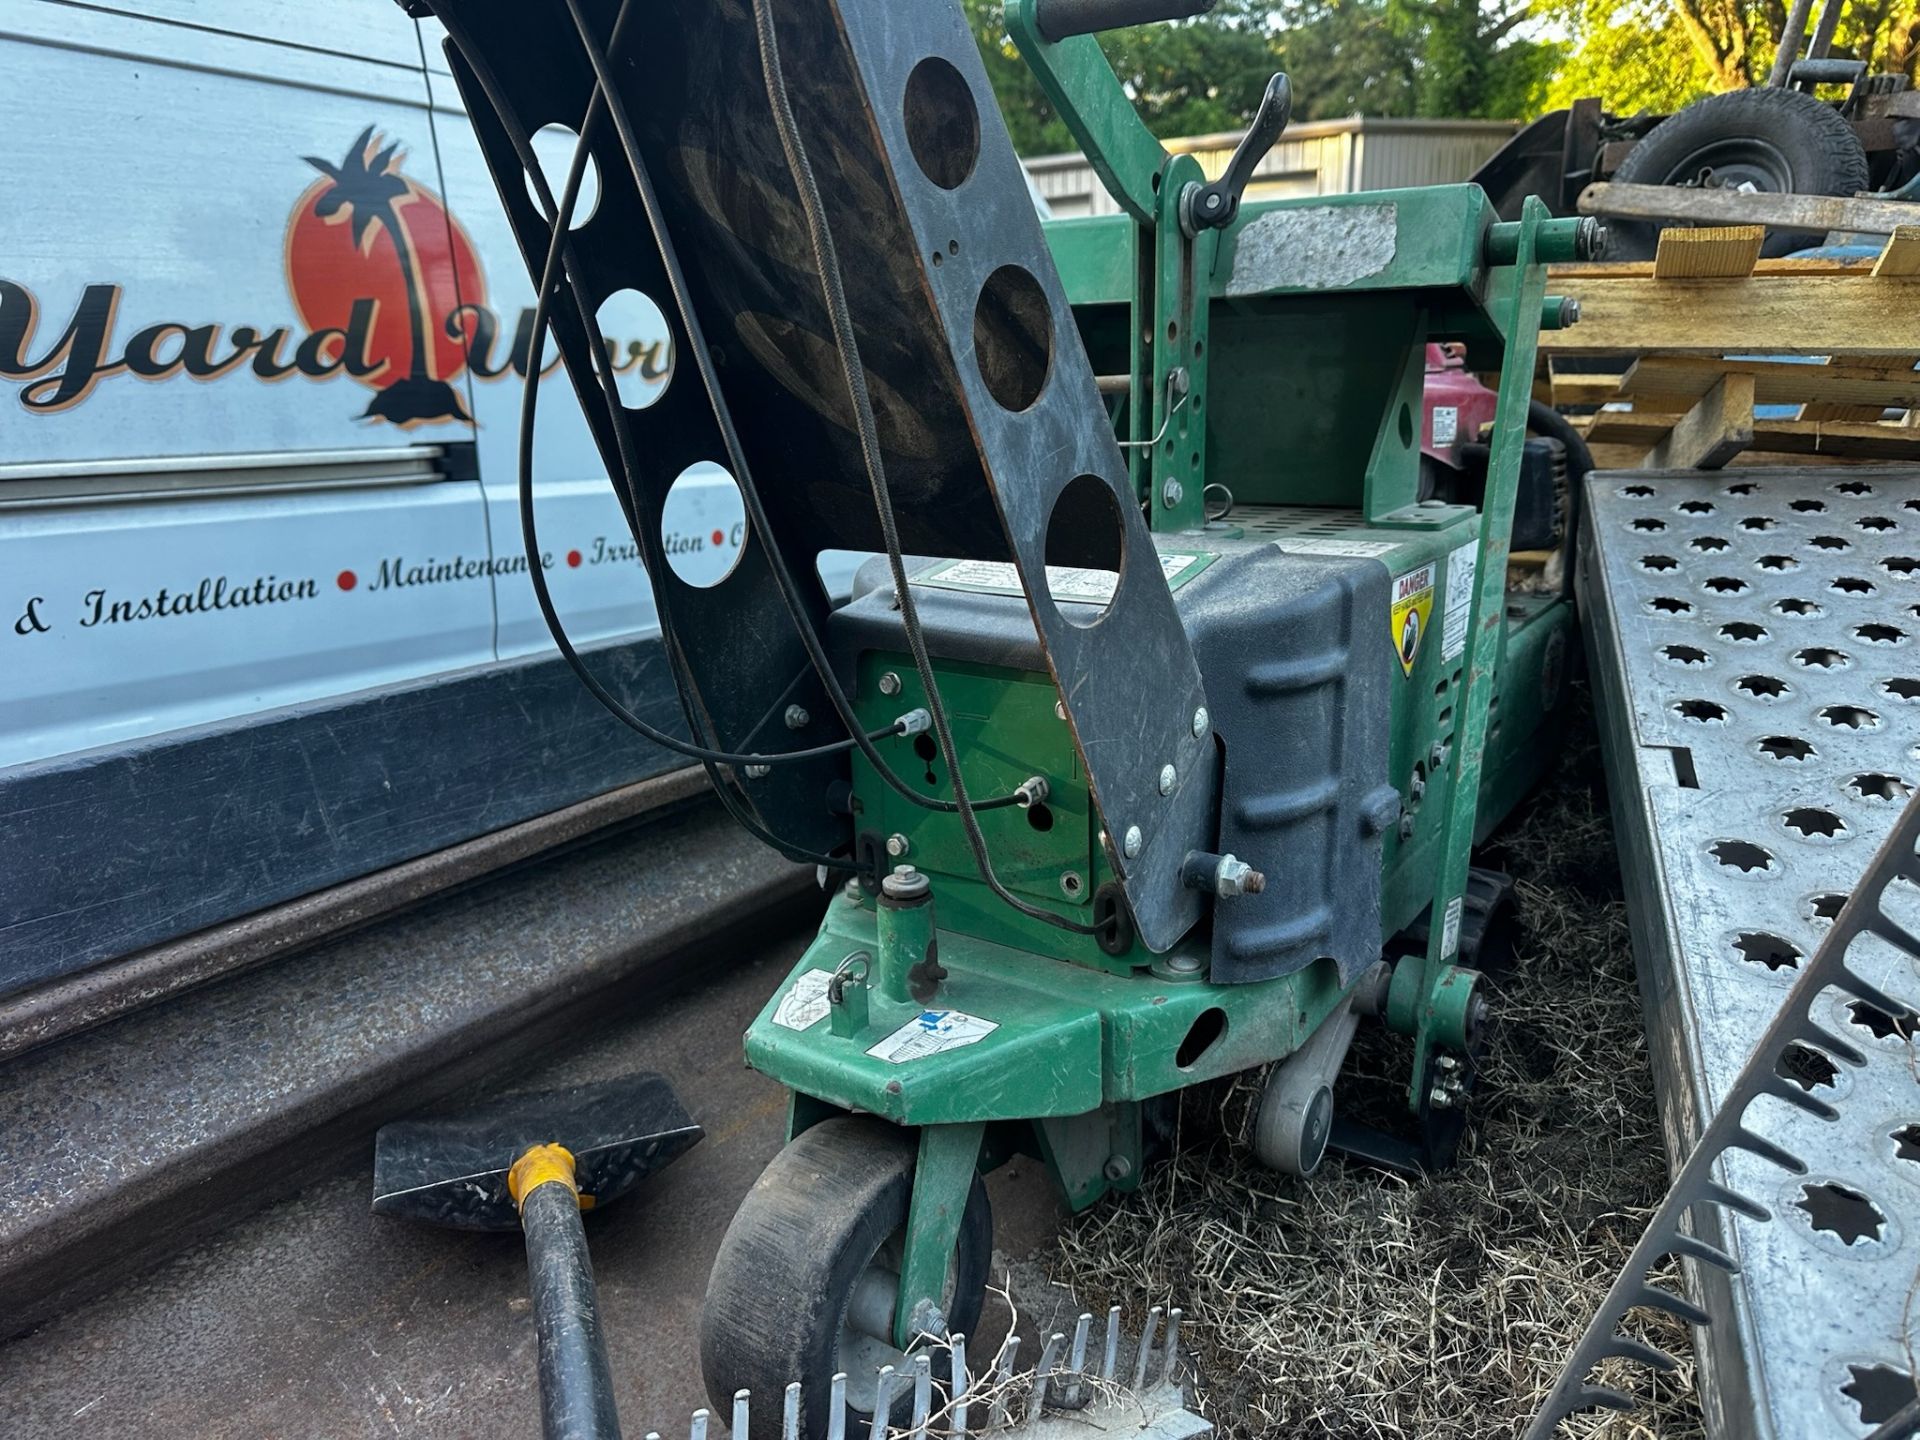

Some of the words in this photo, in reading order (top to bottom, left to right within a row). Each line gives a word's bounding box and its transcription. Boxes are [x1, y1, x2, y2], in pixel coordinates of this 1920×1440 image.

[0, 279, 389, 413] Yard
[14, 597, 51, 635] &
[79, 576, 320, 628] Installation
[368, 551, 556, 592] Maintenane
[590, 531, 706, 567] Irrition
[1399, 568, 1429, 601] DANGER
